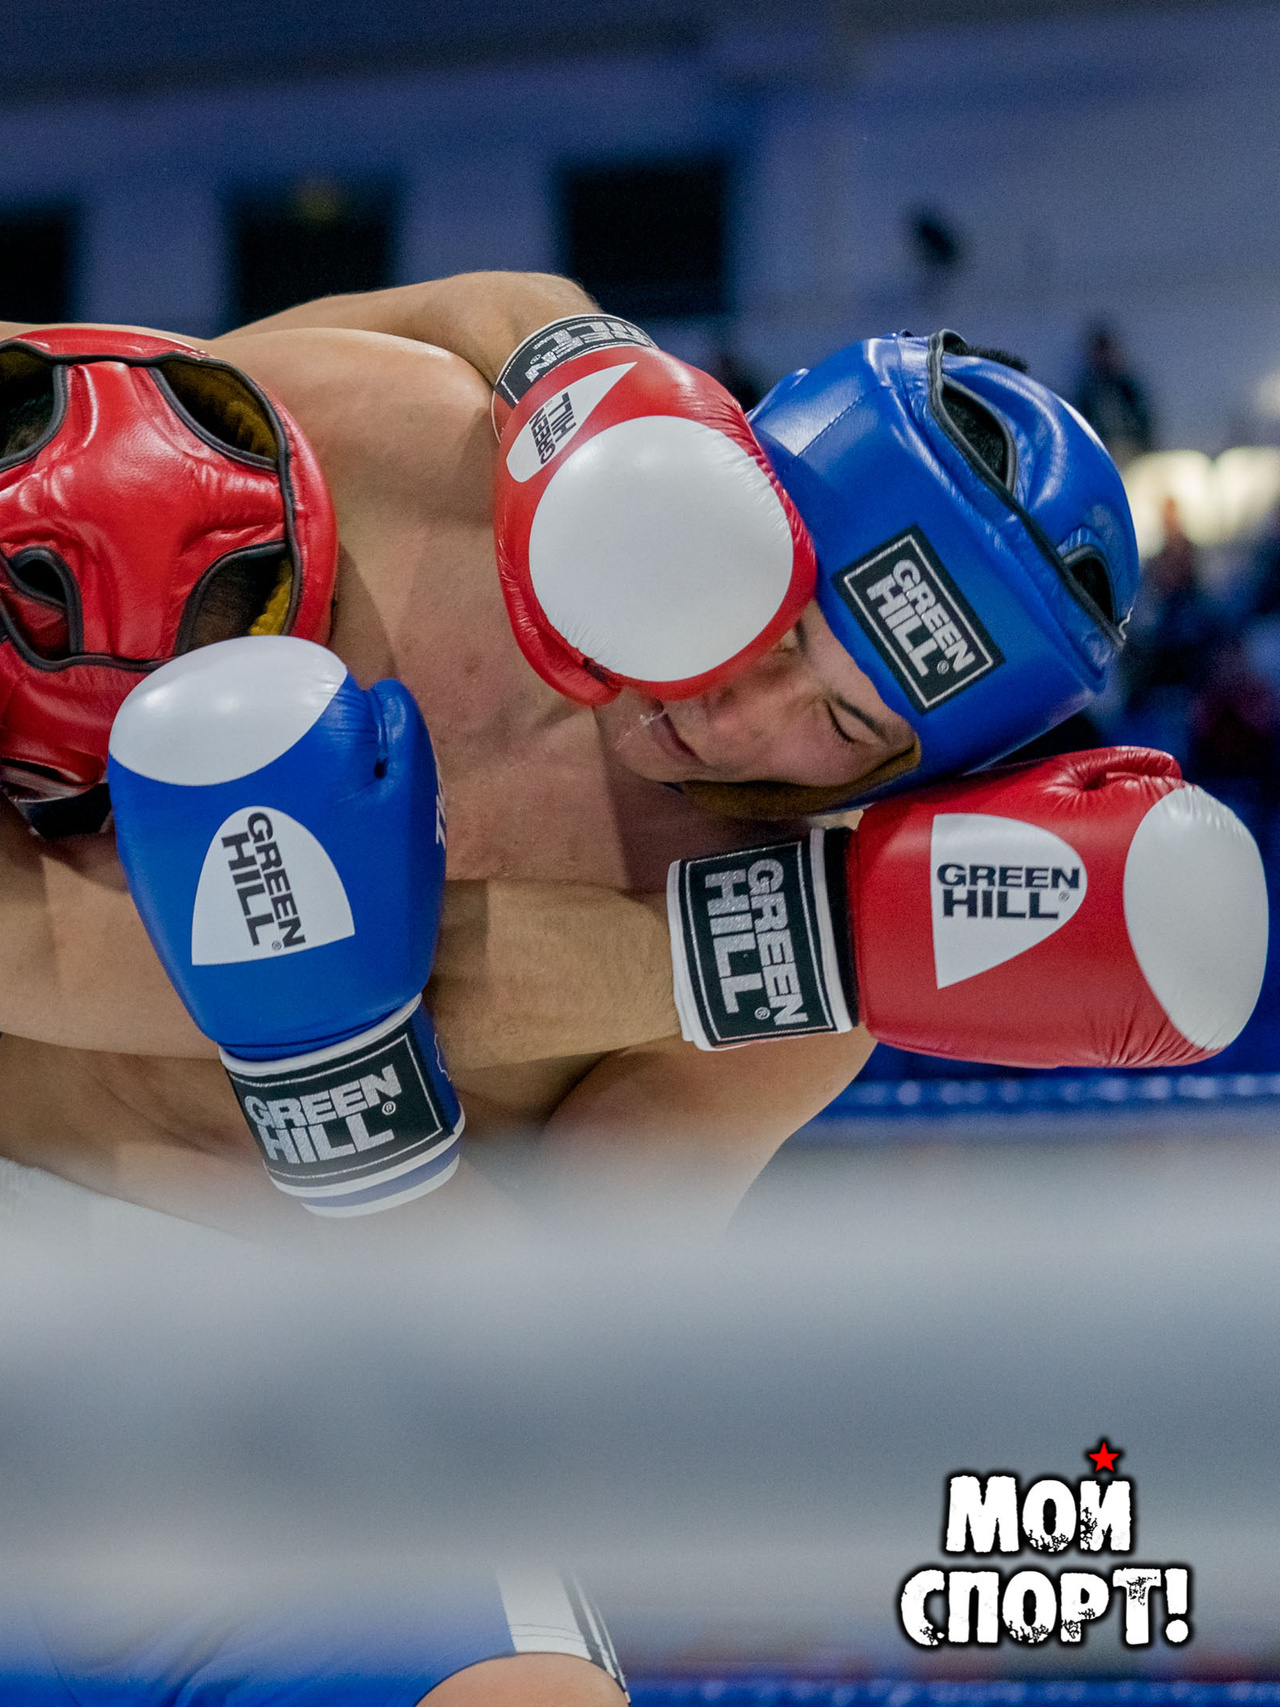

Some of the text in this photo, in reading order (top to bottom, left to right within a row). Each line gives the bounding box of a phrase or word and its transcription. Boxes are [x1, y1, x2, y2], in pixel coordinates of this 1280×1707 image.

[528, 407, 556, 465] GREEN
[548, 392, 577, 444] HILL
[866, 573, 939, 677] HILL
[893, 559, 975, 673] GREEN
[221, 831, 275, 946] HILL
[247, 812, 307, 948] GREEN
[936, 863, 1081, 889] GREEN
[942, 888, 1059, 920] HILL
[705, 869, 764, 1014] HILL
[748, 858, 809, 1026] GREEN
[244, 1063, 402, 1129] GREEN
[257, 1113, 395, 1164] HILL
